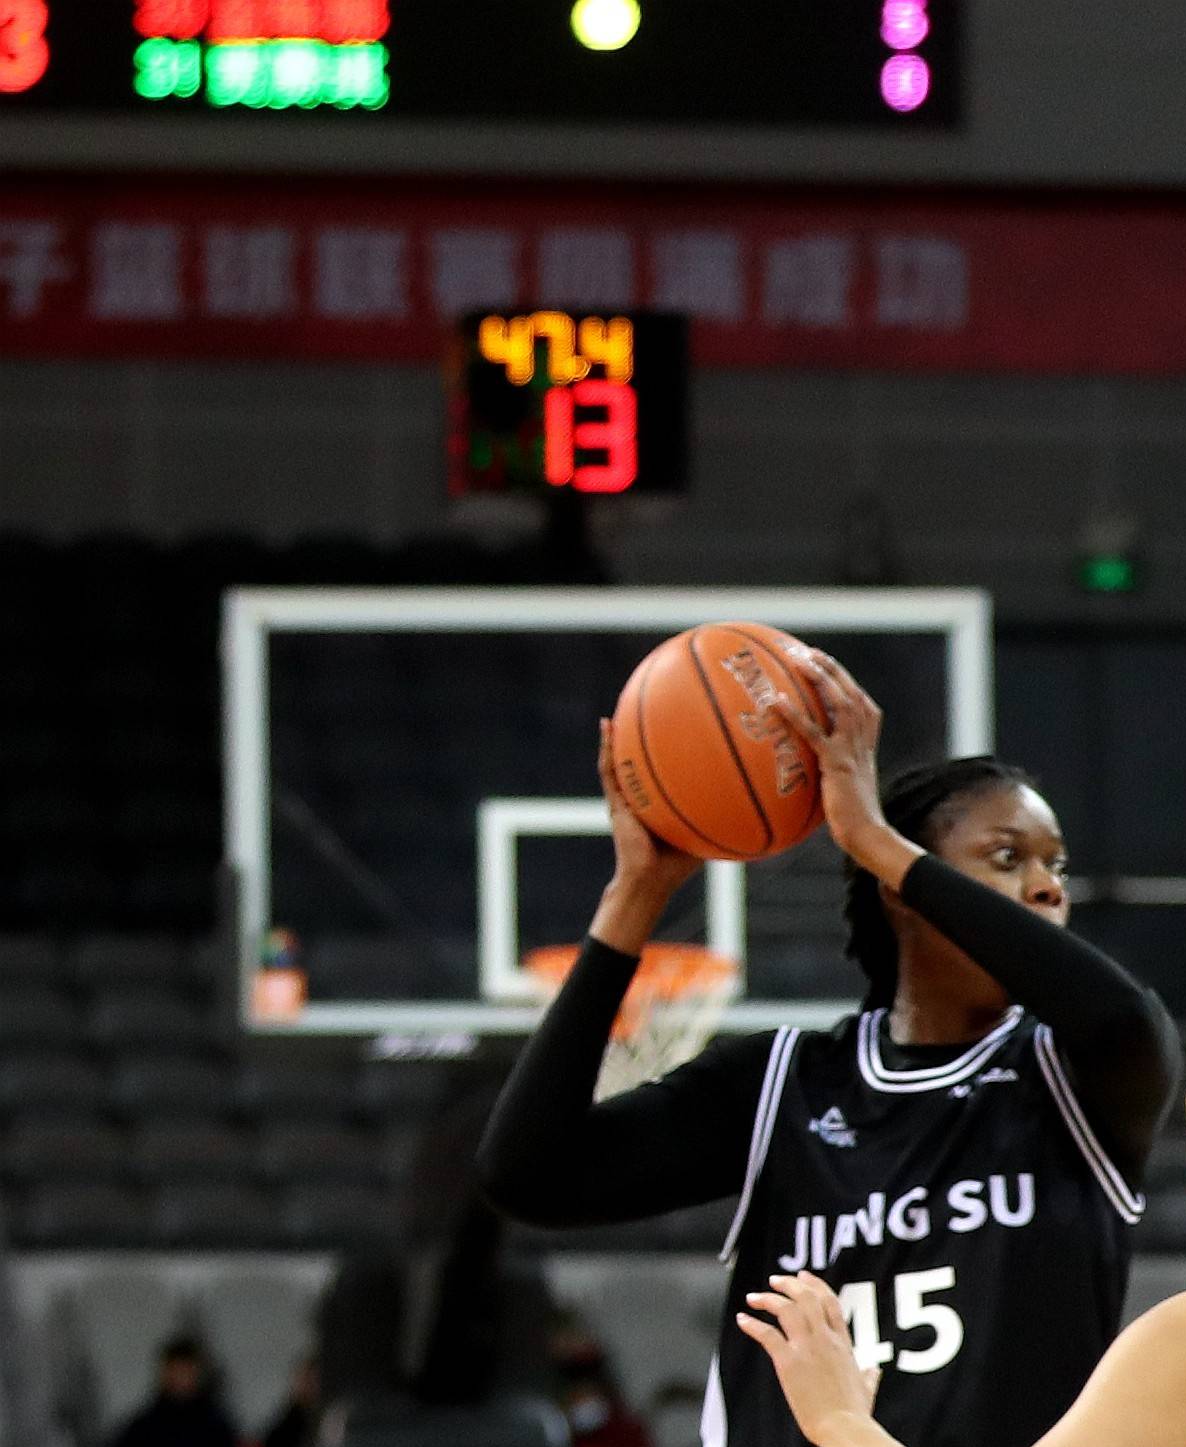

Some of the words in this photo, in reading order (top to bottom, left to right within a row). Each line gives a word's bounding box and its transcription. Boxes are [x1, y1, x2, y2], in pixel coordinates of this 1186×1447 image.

[479, 311, 634, 386] 47.4
[544, 378, 638, 493] 13
[779, 1187, 931, 1271] JIANG
[947, 1173, 1036, 1234] SU
[838, 1266, 965, 1374] 45
